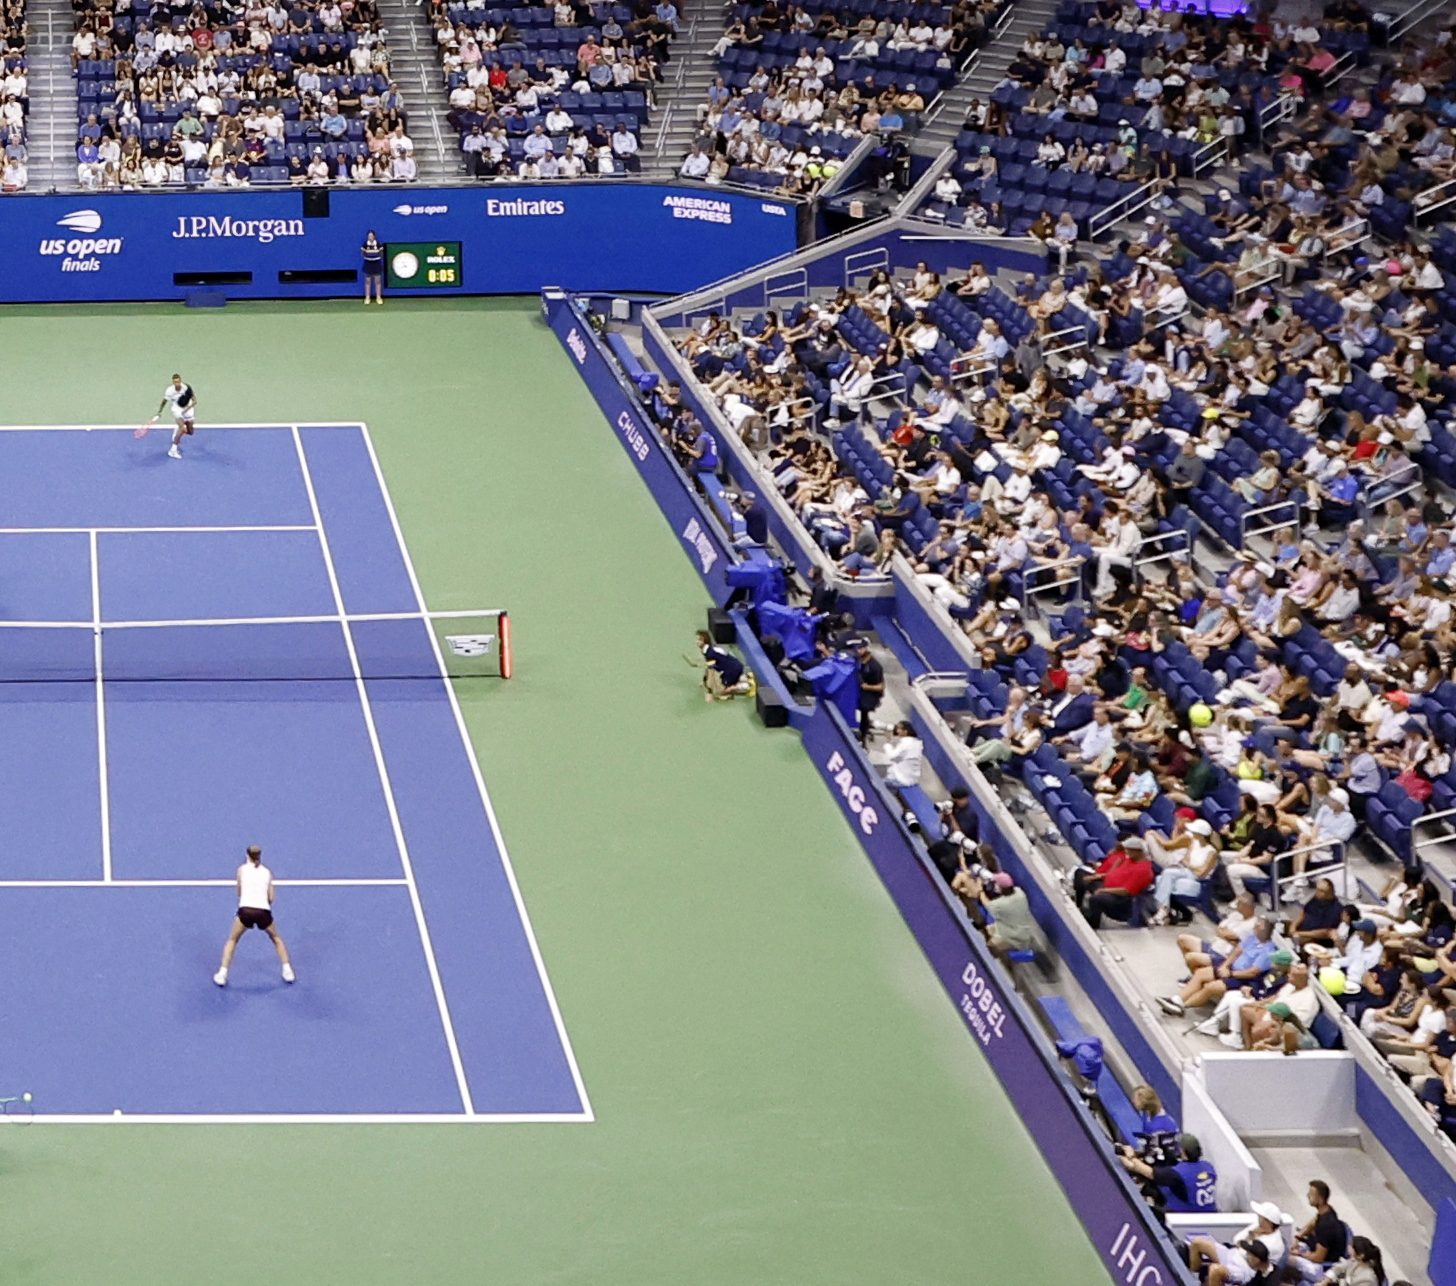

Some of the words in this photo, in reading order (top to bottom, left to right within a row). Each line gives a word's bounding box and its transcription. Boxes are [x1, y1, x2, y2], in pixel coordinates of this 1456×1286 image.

[487, 198, 564, 215] Emirates
[661, 195, 730, 213] AMERICAN
[761, 204, 786, 216] USTA
[672, 207, 731, 224] EXPRESS
[173, 217, 304, 242] J.P.Morgan
[40, 239, 64, 255] us
[66, 238, 121, 258] open
[62, 256, 100, 271] finals
[427, 256, 455, 264] ROLEX
[428, 269, 455, 282] 0:05
[618, 411, 649, 461] CHUBB
[961, 961, 1007, 1039] DOBEL
